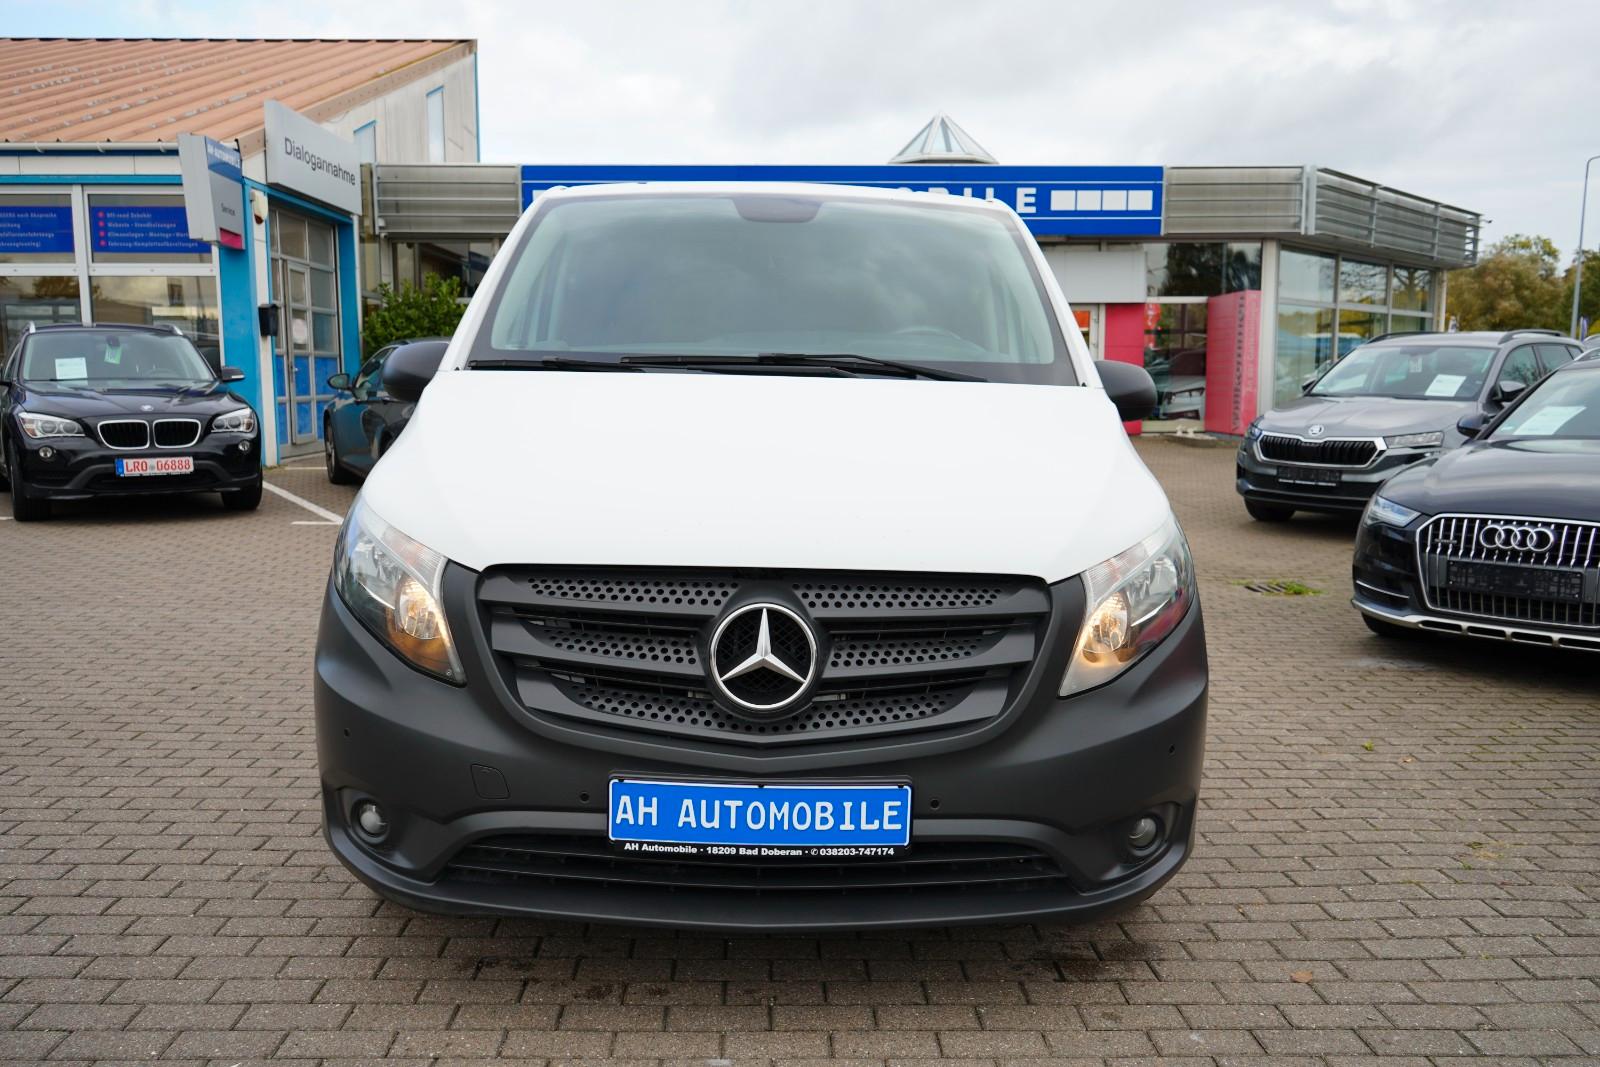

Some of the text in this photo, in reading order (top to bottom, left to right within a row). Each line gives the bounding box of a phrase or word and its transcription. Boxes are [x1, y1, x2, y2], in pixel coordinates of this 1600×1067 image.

[284, 136, 356, 186] Dialogannahme
[125, 460, 148, 473] LRO
[615, 795, 902, 831] AH AUTOMOBILE
[624, 843, 895, 856] AH Automobile 18209 Bad Doberan 038203-747174
